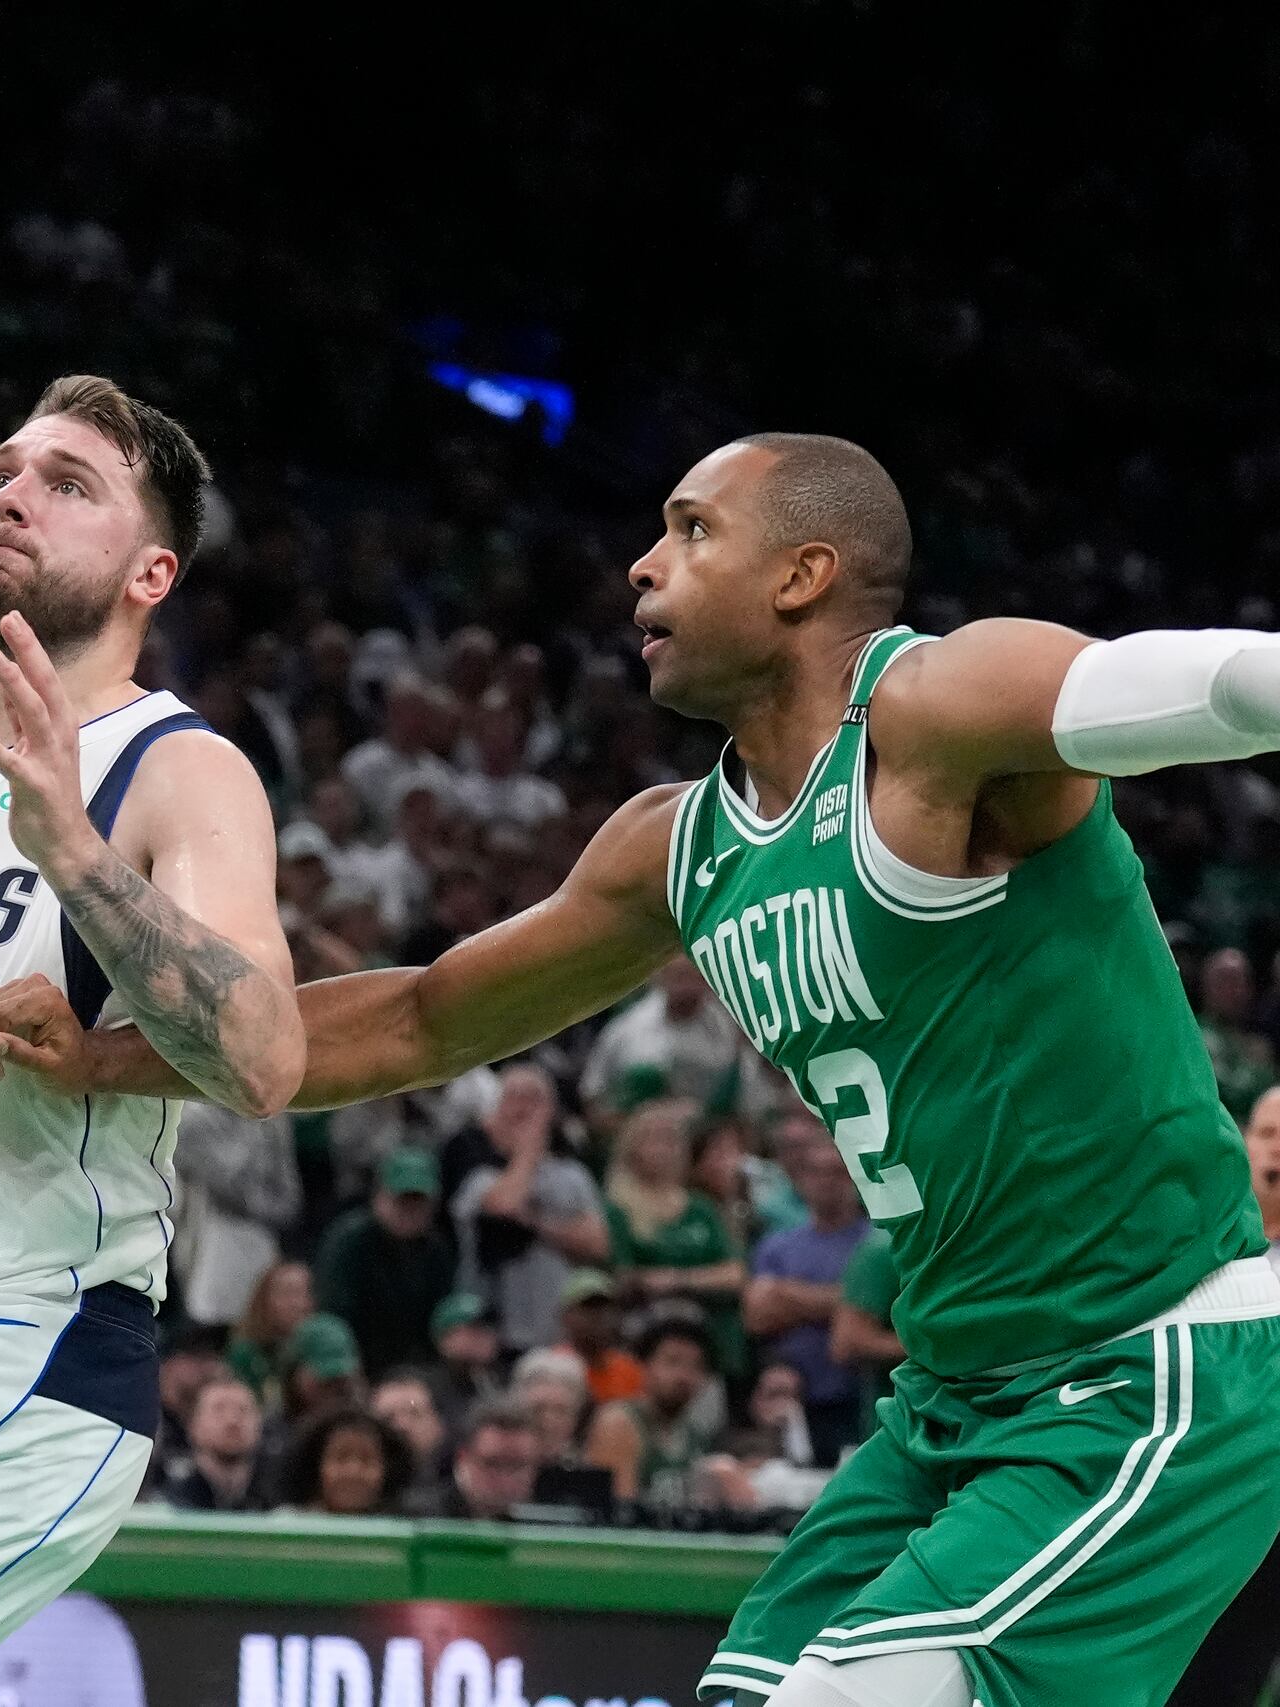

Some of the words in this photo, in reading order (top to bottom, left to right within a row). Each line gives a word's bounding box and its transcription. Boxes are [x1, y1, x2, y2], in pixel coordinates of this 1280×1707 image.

[815, 784, 848, 823] VISTA
[813, 811, 845, 846] PRINT
[782, 1048, 924, 1219] 2
